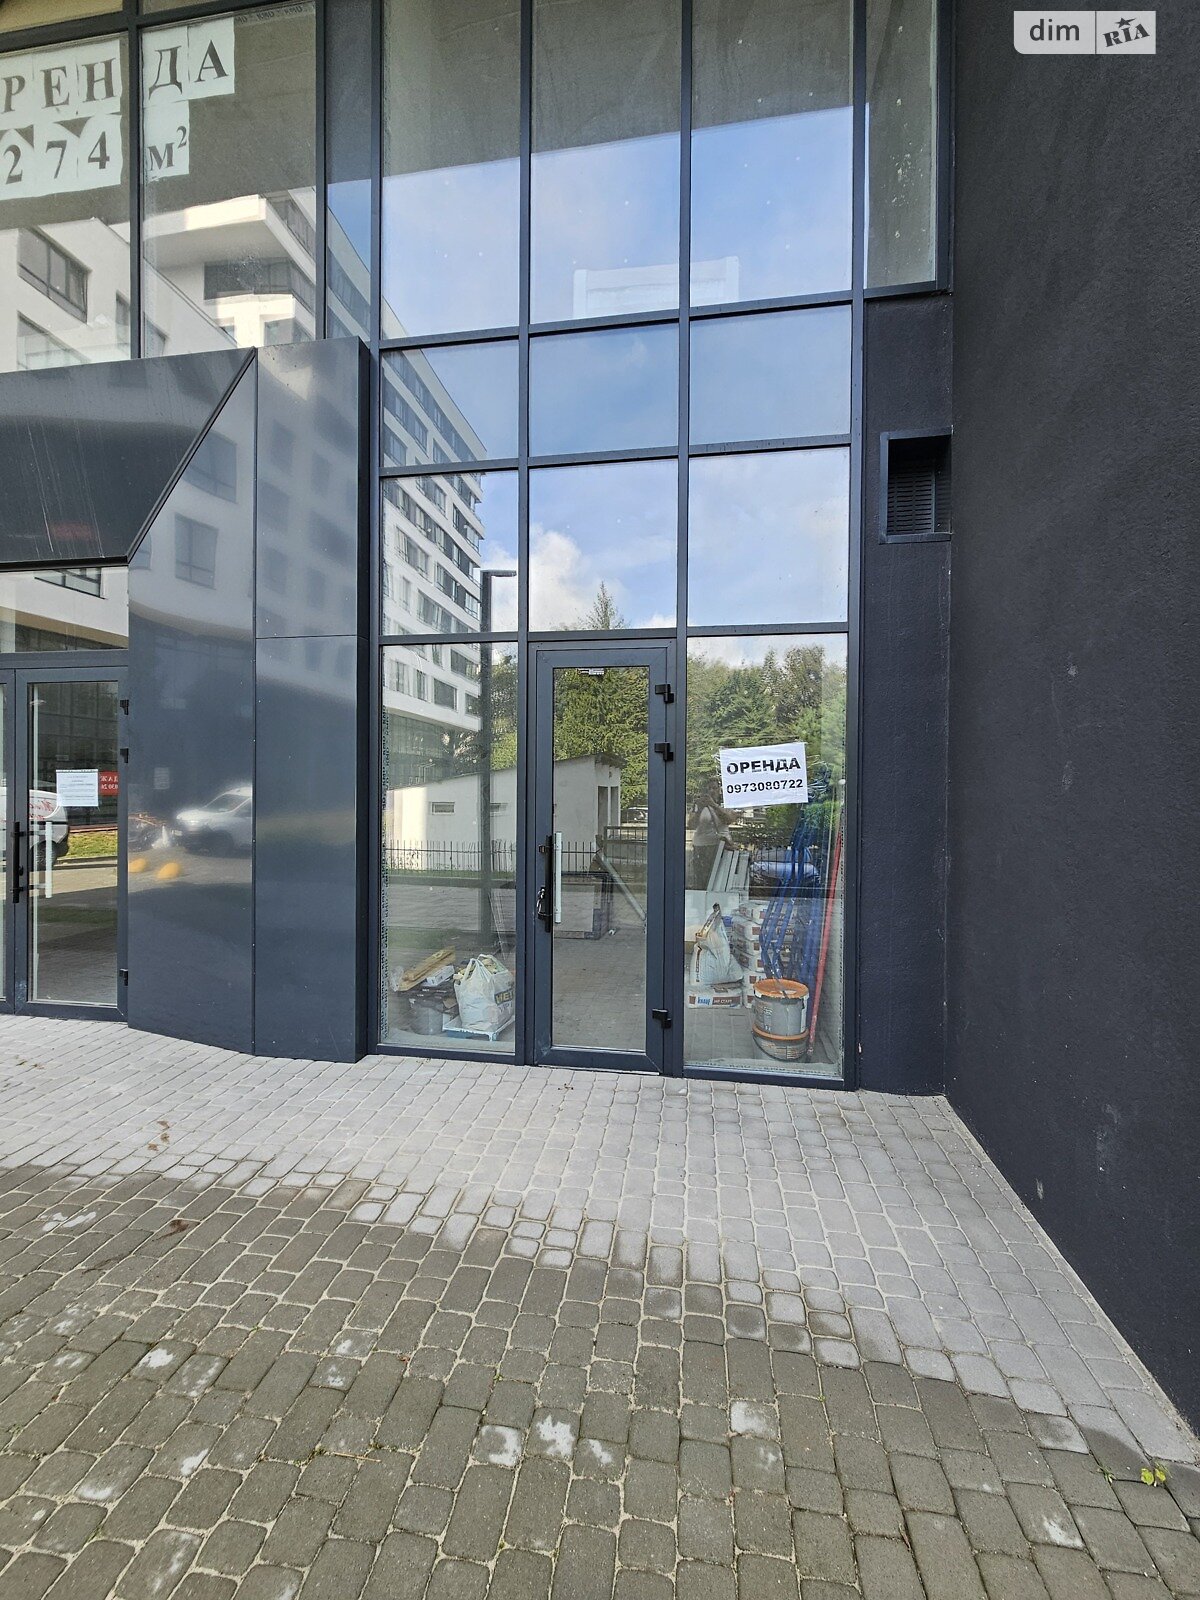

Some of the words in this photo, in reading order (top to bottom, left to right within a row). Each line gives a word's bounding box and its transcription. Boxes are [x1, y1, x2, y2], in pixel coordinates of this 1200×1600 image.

[3, 131, 111, 185] 274
[726, 757, 801, 775] ОРЕНДА
[726, 778, 804, 794] 0973080722
